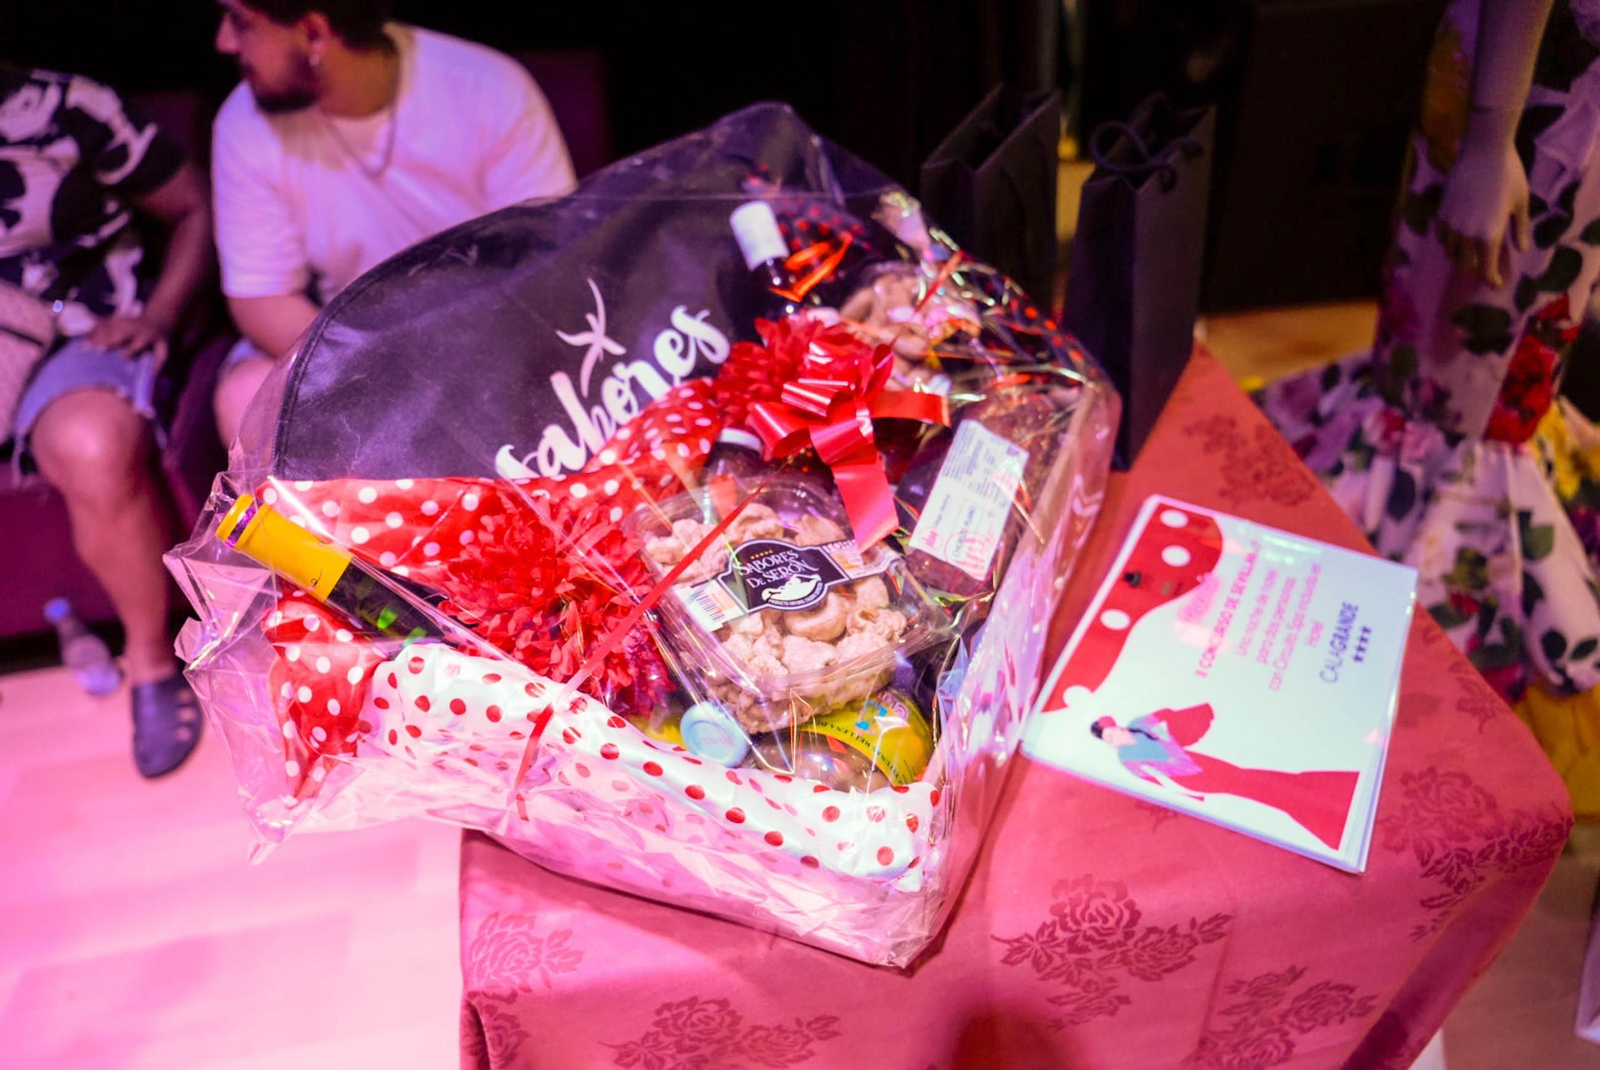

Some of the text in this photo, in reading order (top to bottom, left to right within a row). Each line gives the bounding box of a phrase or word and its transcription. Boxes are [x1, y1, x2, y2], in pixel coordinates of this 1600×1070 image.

[733, 550, 799, 576] SABORES
[1223, 596, 1240, 611] DE
[1319, 602, 1358, 683] CALAGRANDE
